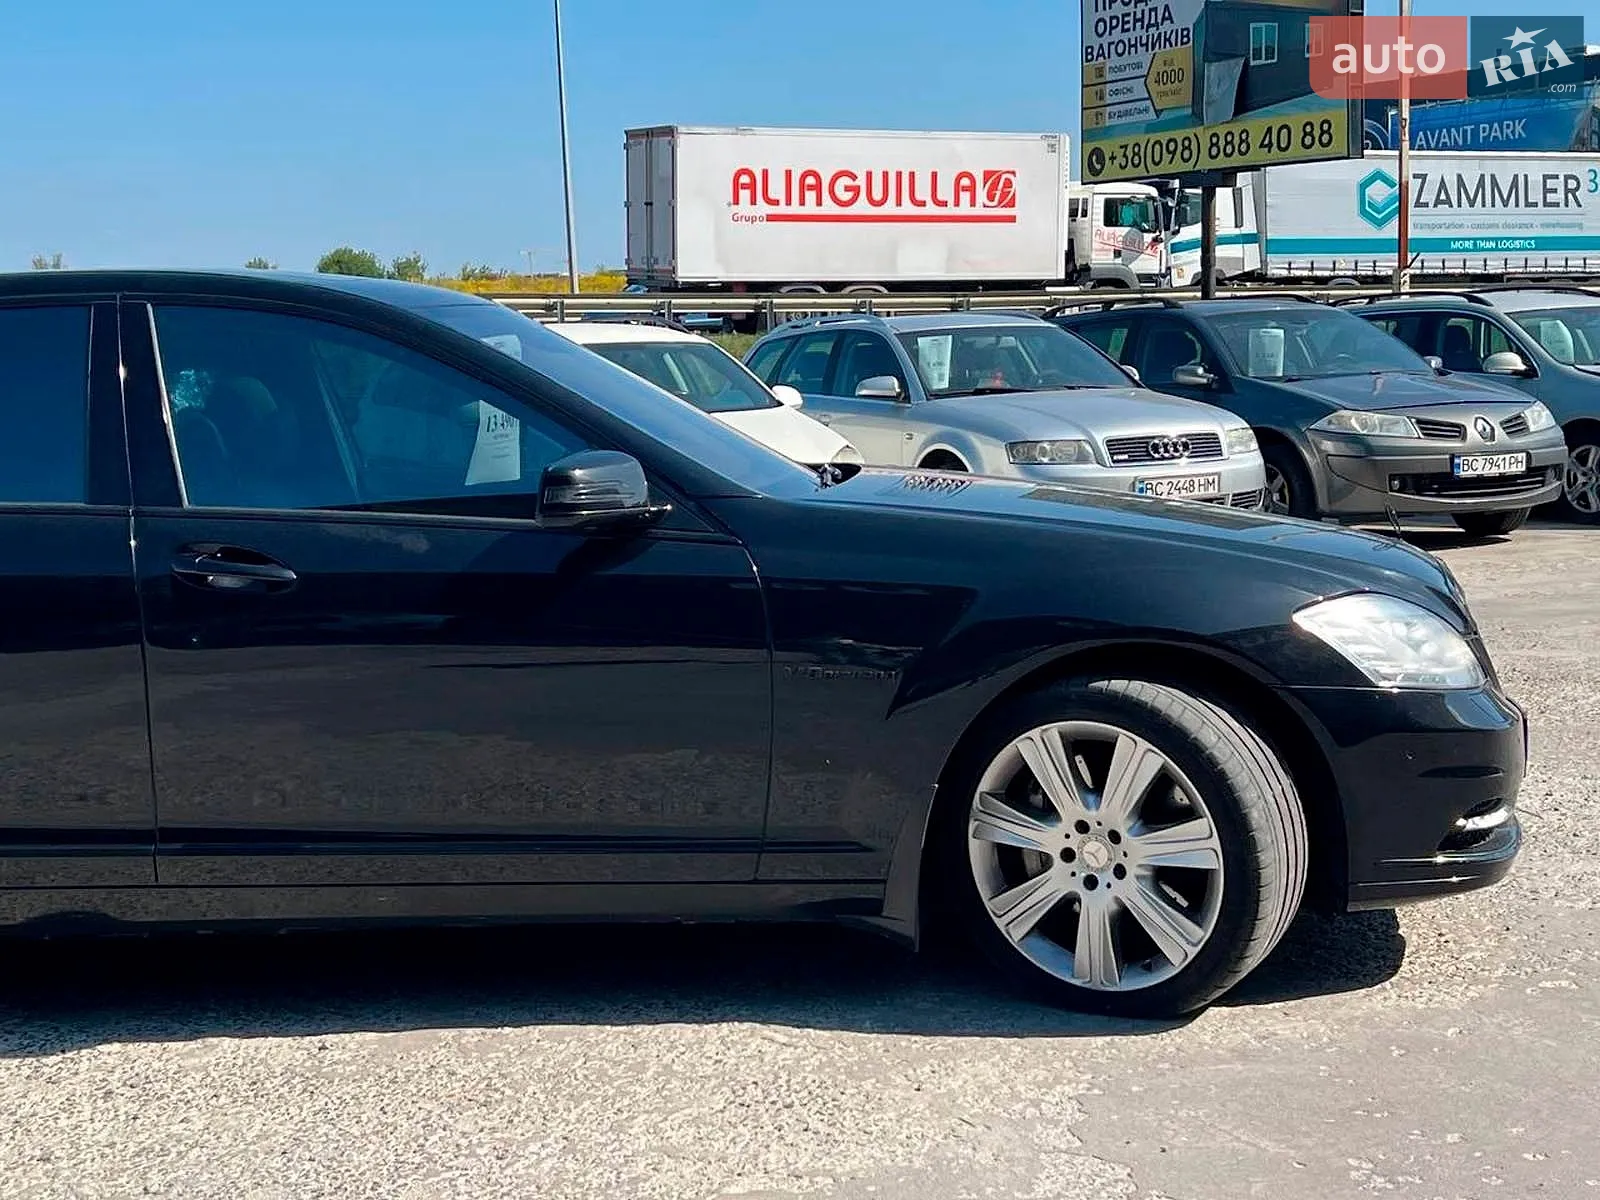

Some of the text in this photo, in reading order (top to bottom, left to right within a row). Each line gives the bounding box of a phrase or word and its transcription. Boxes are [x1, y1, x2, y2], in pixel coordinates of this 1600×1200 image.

[1094, 4, 1174, 38] ОРЕНДА
[1085, 27, 1191, 63] ВАГОНЧИКІВ
[1154, 67, 1185, 86] 4000
[1108, 118, 1333, 174] +38(098) 888 40 88
[1414, 118, 1528, 150] AVANT PARK
[732, 168, 976, 208] ALIAGUILLA
[1412, 173, 1583, 209] ZAMMLER
[731, 213, 765, 223] Grupo
[1450, 239, 1536, 249] MORE THAN LOGISTICS
[1460, 455, 1524, 472] BC 7941 PH
[1145, 477, 1216, 496] BC 2448 HM
